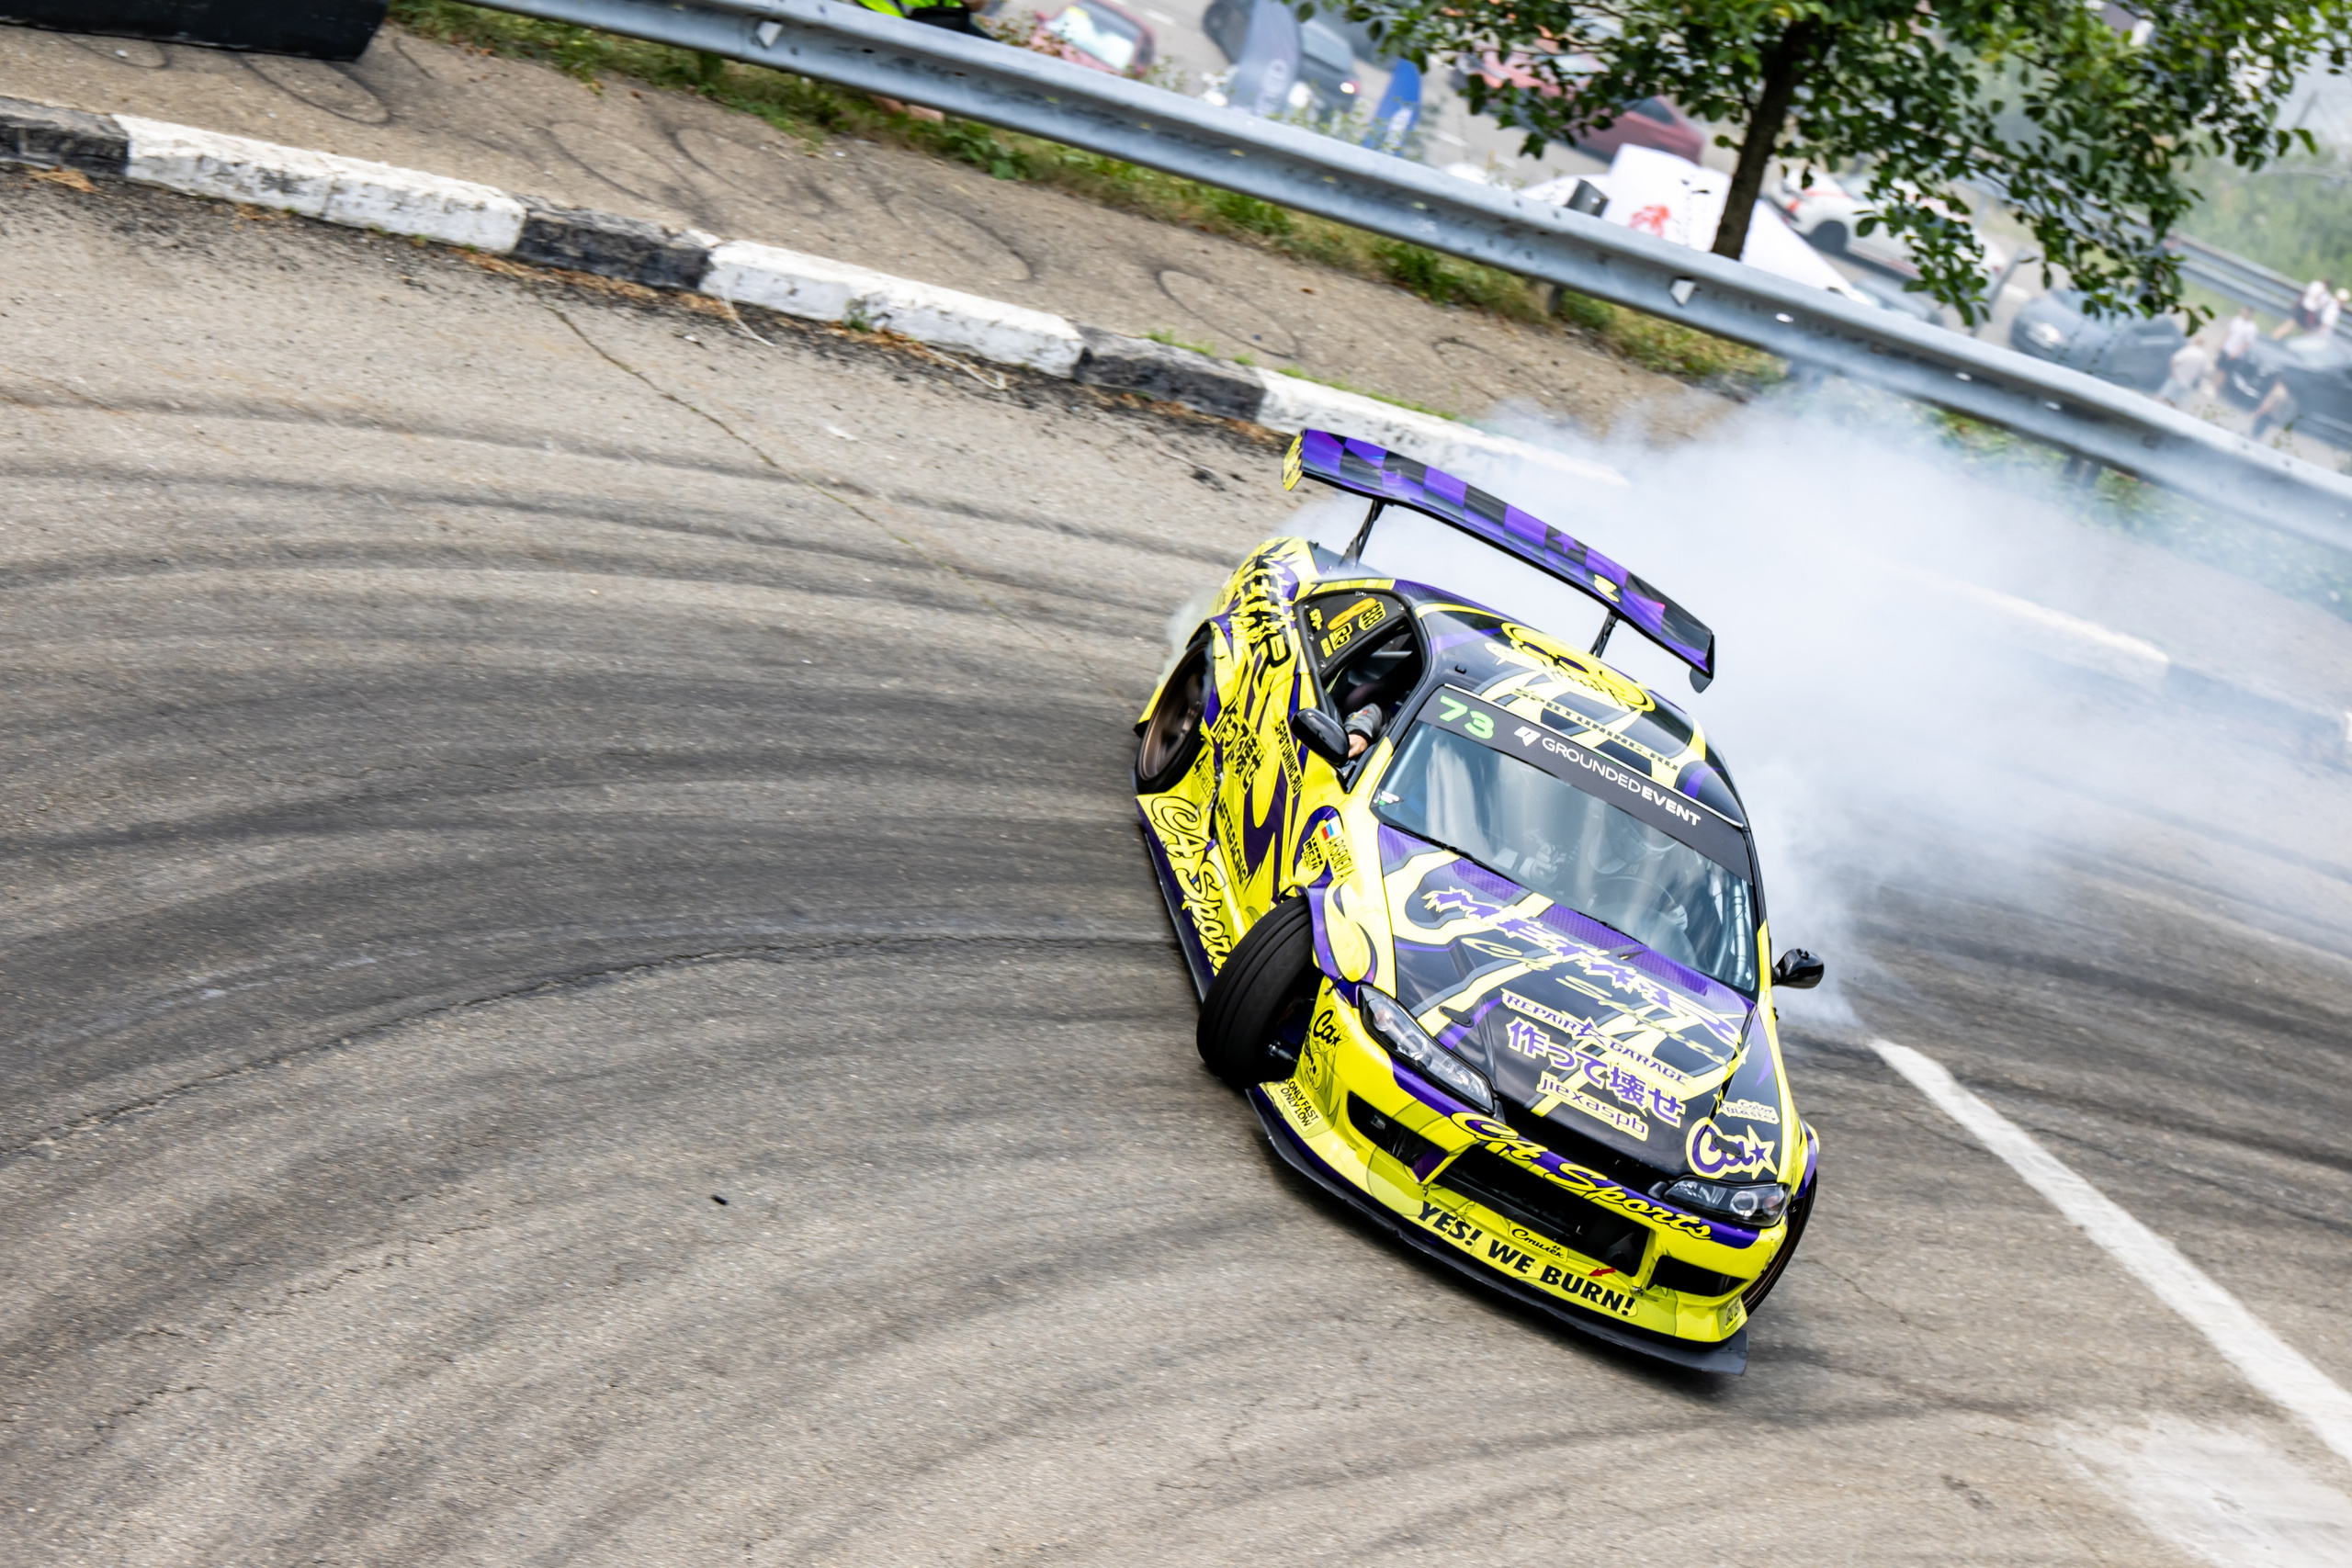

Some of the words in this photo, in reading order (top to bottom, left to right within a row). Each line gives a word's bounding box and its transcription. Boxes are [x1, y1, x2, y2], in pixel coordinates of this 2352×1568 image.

[1439, 694, 1495, 739] 73
[1152, 796, 1209, 859] CA
[1510, 1019, 1684, 1124] 作って壊せ
[1609, 1040, 1690, 1086] GARAGE
[1281, 1088, 1299, 1108] ONLY
[1295, 1106, 1312, 1127] LOW
[1288, 1080, 1306, 1101] ONLY
[1301, 1100, 1319, 1121] FAST
[1540, 1075, 1647, 1135] jiexaspb
[1543, 1162, 1712, 1241] Sports
[1418, 1201, 1483, 1247] YES!
[1487, 1238, 1536, 1275] WE
[1539, 1264, 1637, 1316] BURN!
